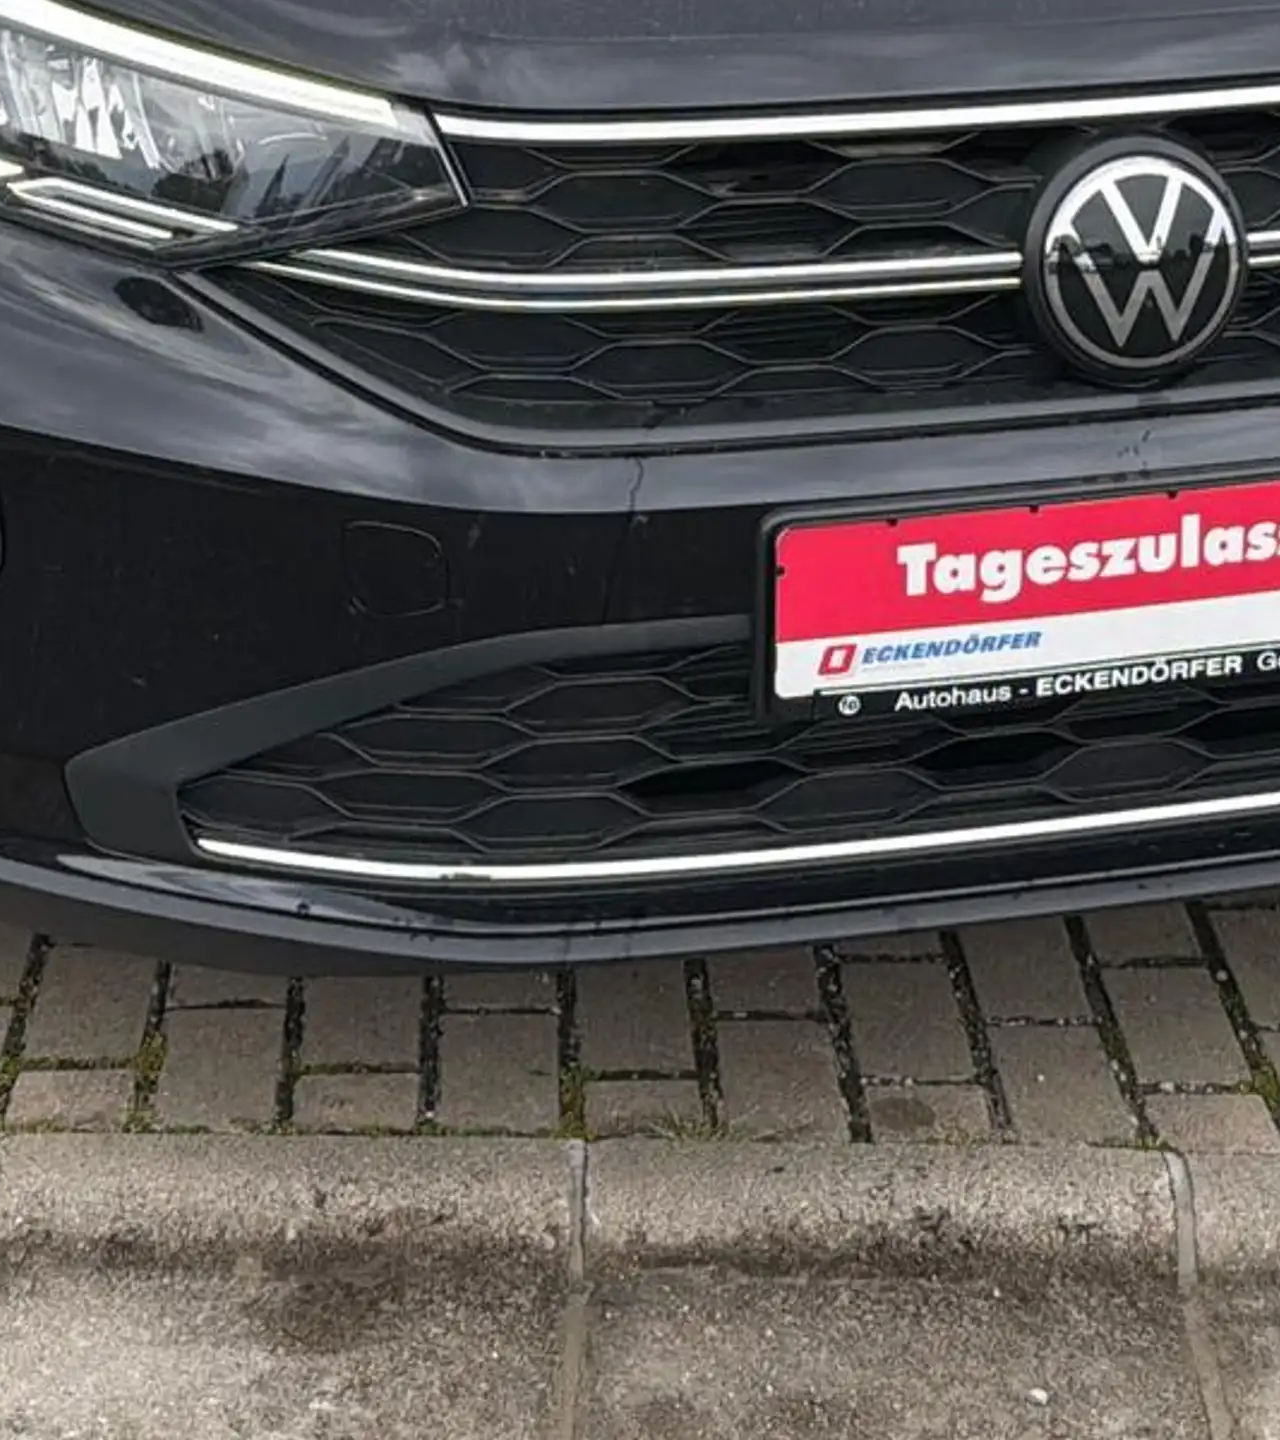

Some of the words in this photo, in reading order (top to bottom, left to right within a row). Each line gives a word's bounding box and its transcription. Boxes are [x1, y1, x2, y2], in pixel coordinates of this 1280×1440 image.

[1050, 160, 1234, 357] VW
[861, 630, 1043, 666] ECKENDÖRFER
[894, 682, 1013, 713] Autohaus
[1035, 653, 1243, 699] ECKENDÖRFER
